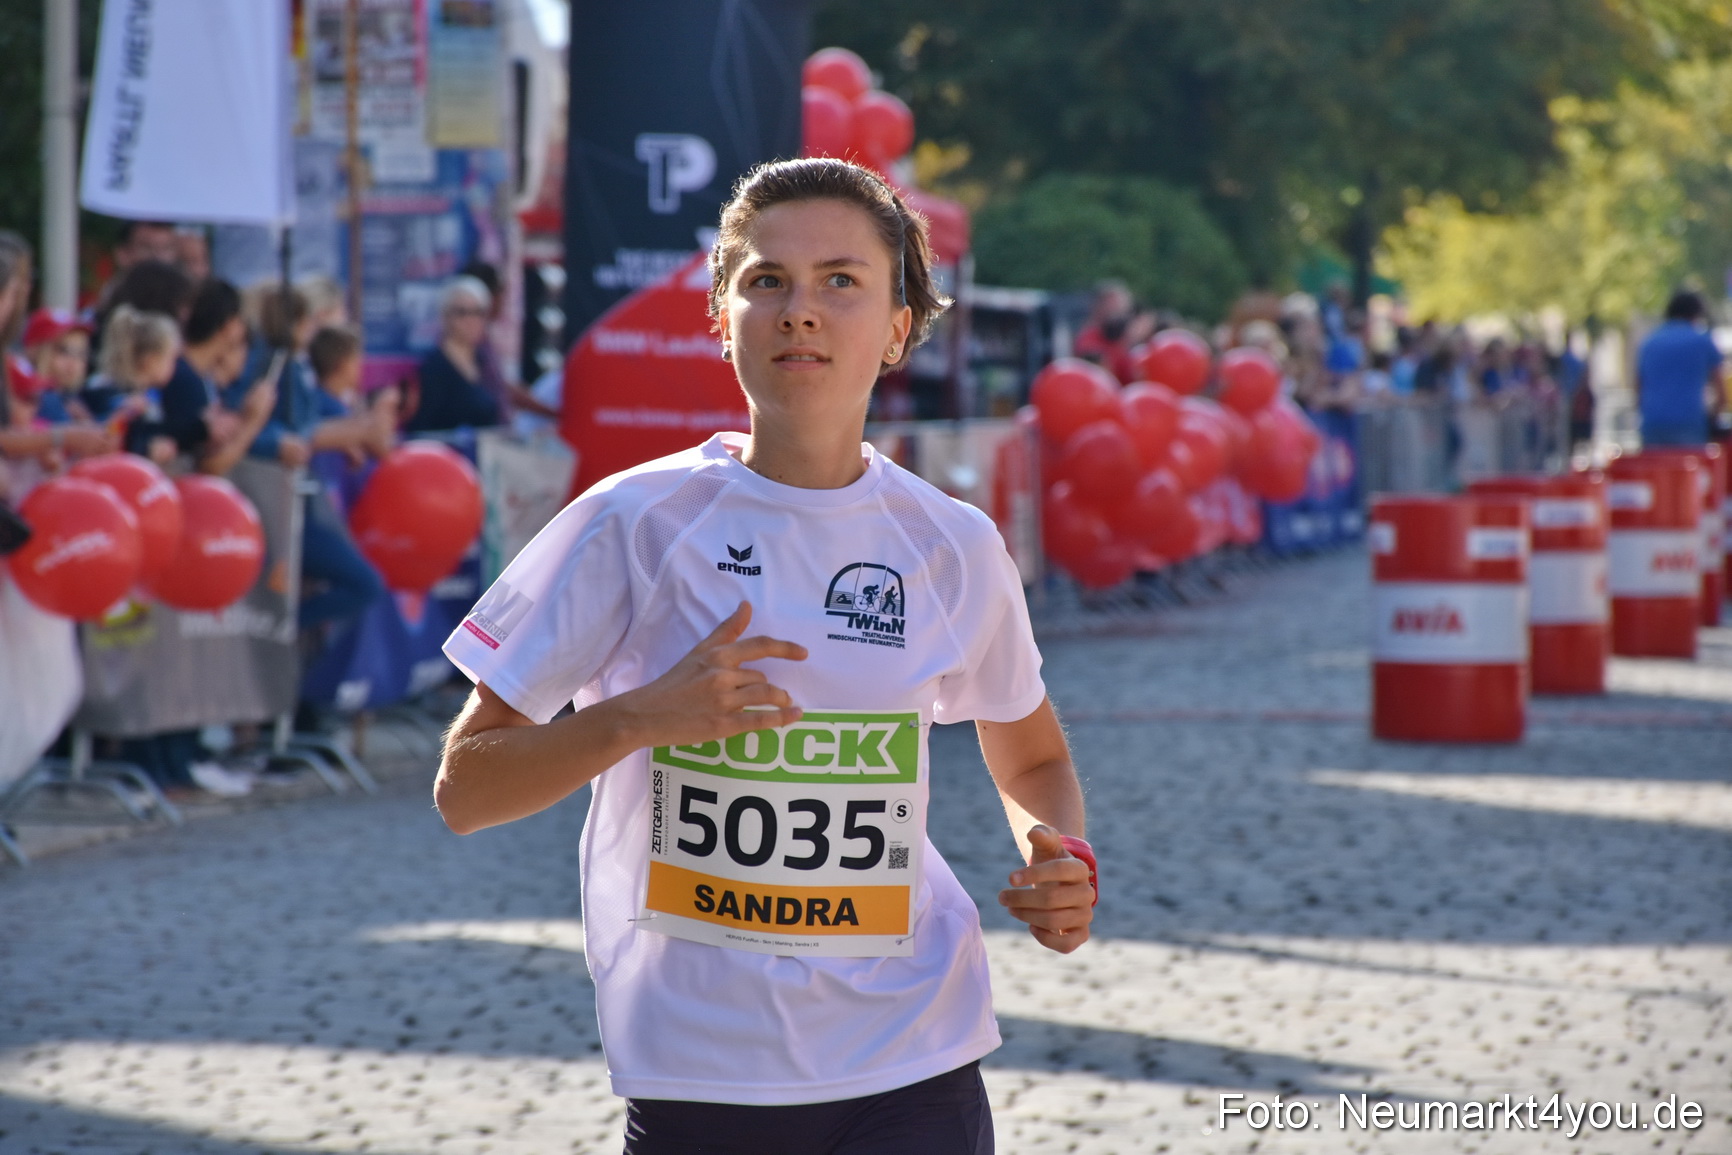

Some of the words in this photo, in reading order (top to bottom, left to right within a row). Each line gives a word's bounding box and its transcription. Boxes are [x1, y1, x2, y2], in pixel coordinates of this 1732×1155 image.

[717, 562, 761, 576] erima
[826, 611, 905, 635] TWinN
[827, 634, 868, 644] WINDSCHATTEN
[861, 631, 906, 643] TRIATHLONVEREIN
[896, 804, 907, 818] S
[677, 784, 886, 870] 5035
[694, 884, 860, 926] SANDRA
